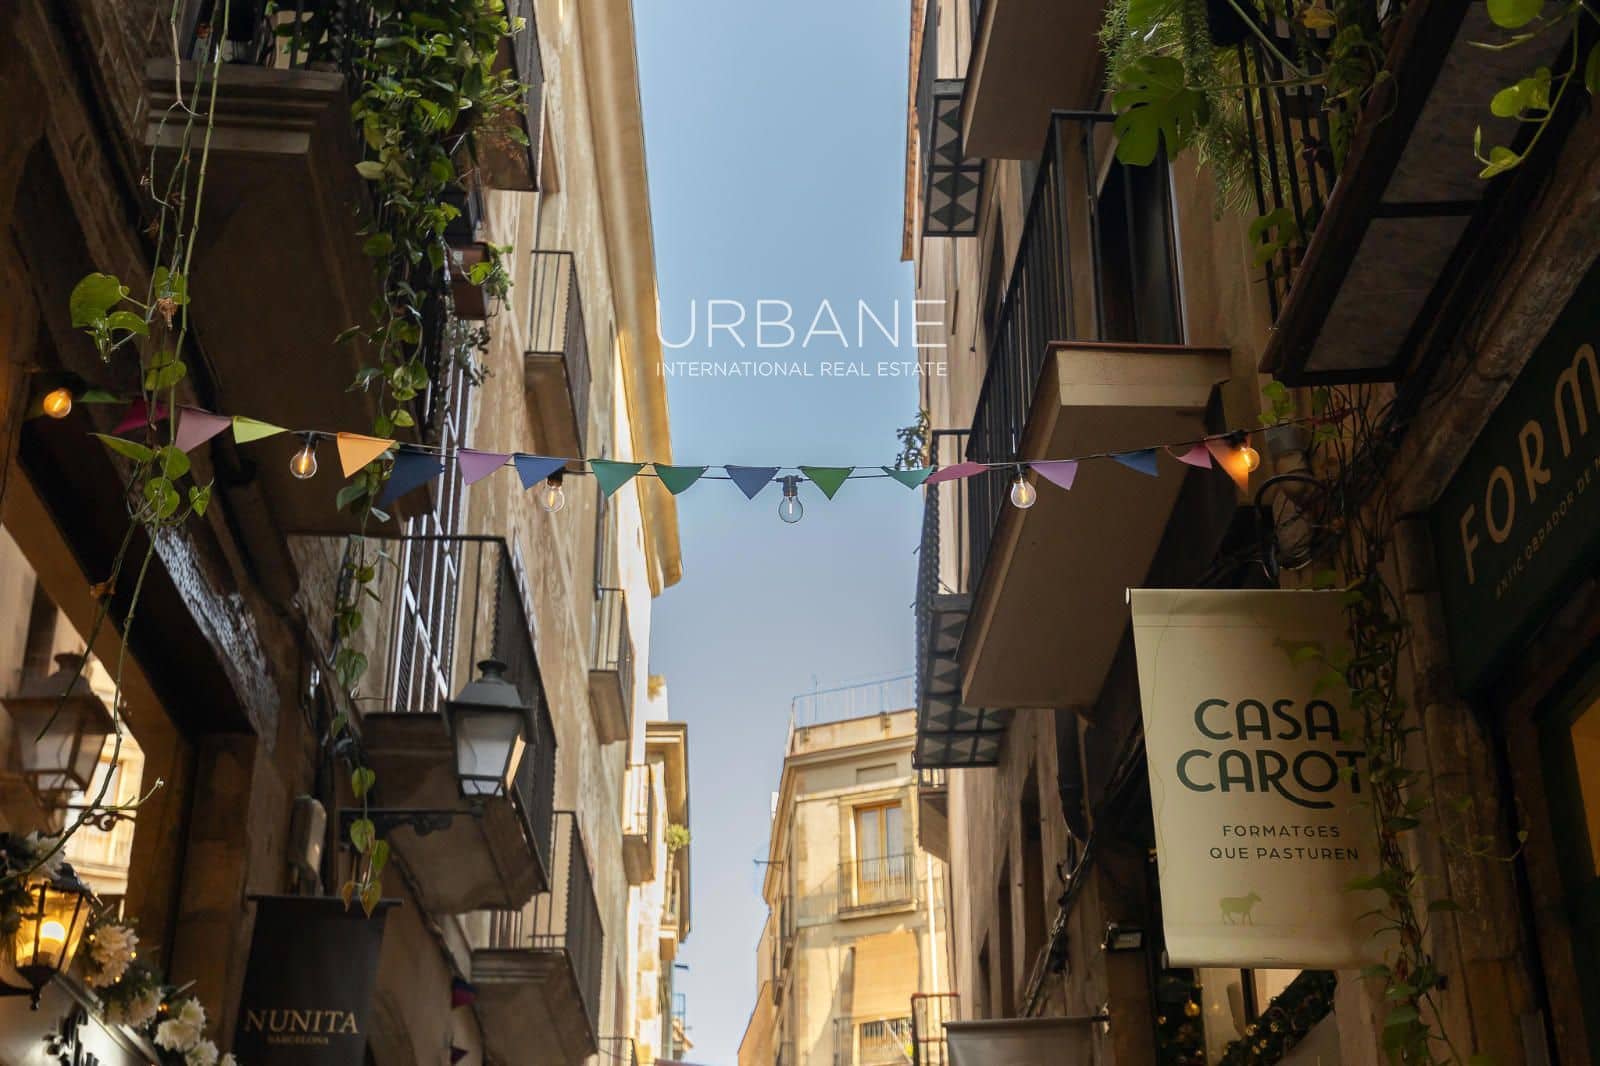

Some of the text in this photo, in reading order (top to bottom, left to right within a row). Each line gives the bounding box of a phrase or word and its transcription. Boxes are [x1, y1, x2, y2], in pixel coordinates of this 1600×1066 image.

[1194, 699, 1342, 741] CASA
[1176, 750, 1367, 809] CAROT
[1223, 824, 1341, 839] FORMATGES
[1209, 847, 1360, 862] QUE PASTUREN
[245, 1008, 360, 1035] NUNITA
